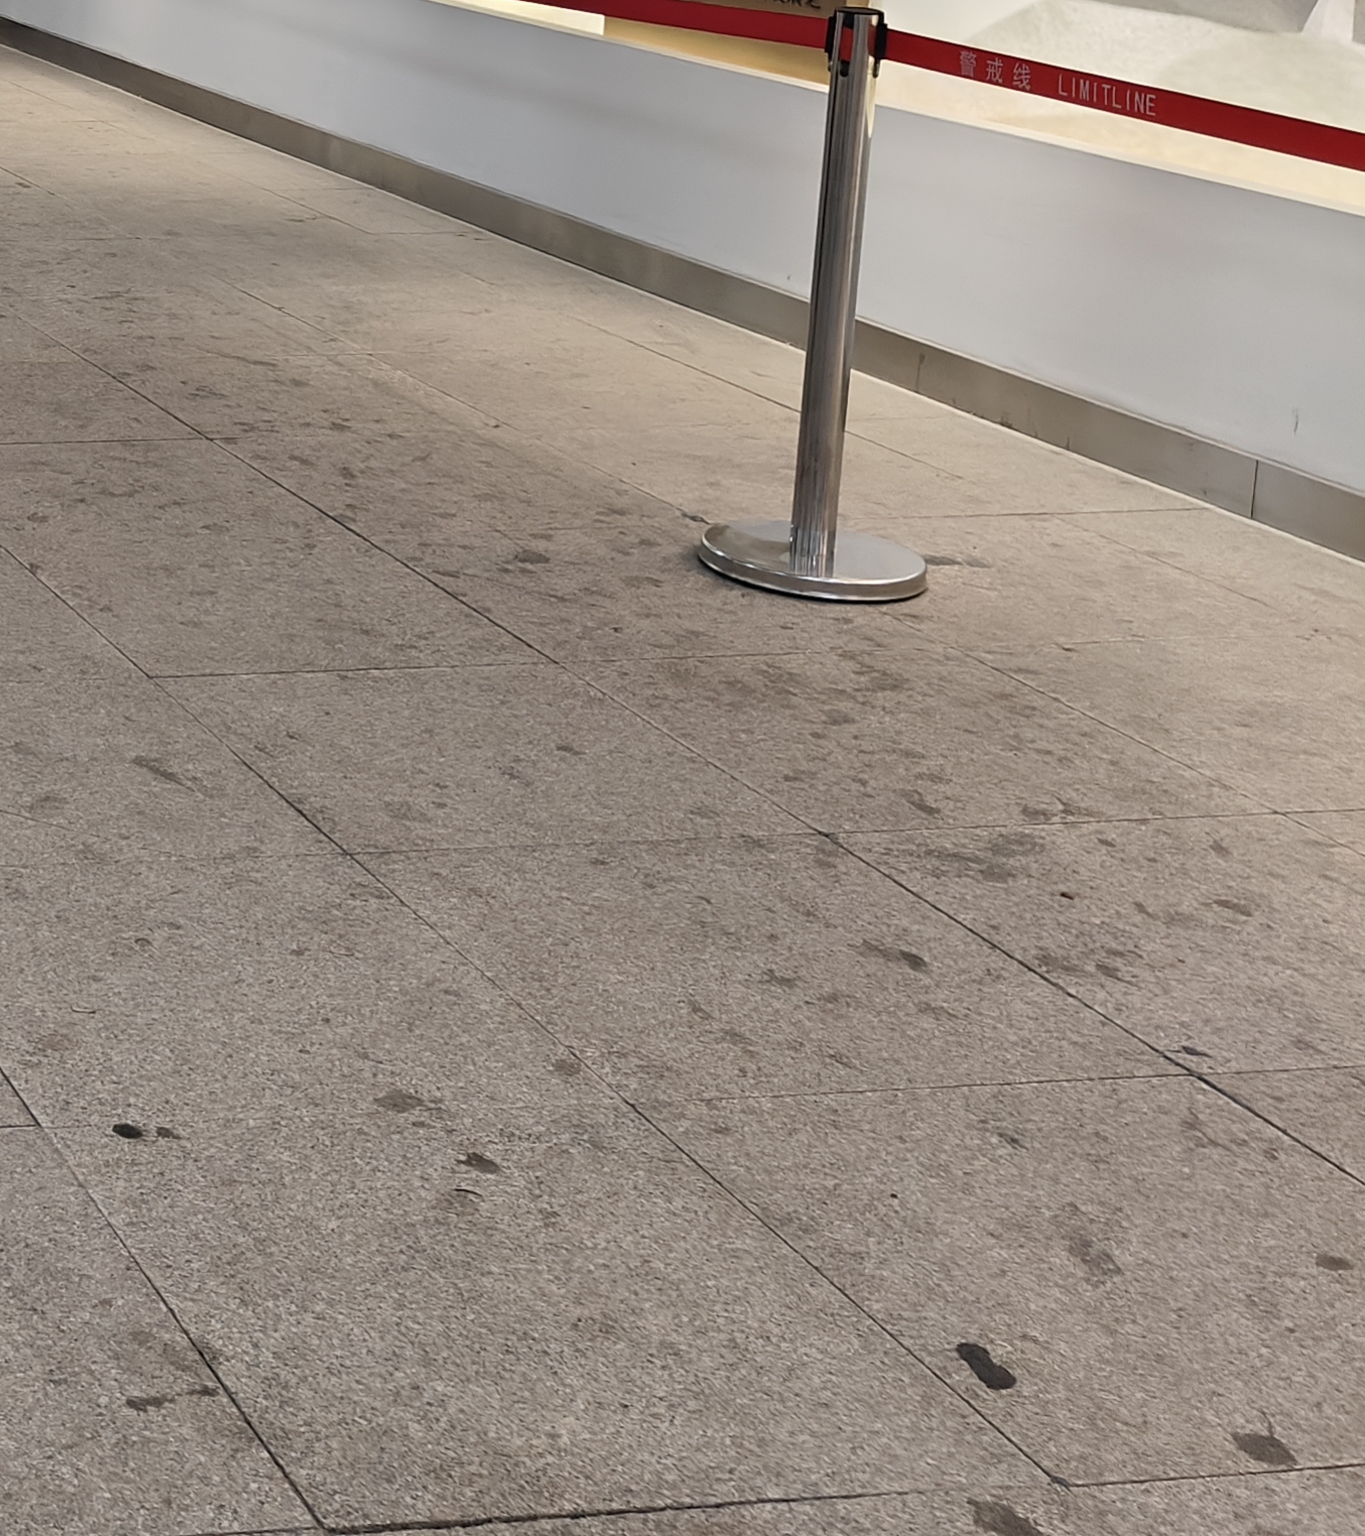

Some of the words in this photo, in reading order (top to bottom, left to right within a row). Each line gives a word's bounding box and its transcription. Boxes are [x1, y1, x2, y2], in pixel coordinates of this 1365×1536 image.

[959, 49, 1032, 91] 警戒线
[1058, 74, 1157, 116] LIMITLINE
